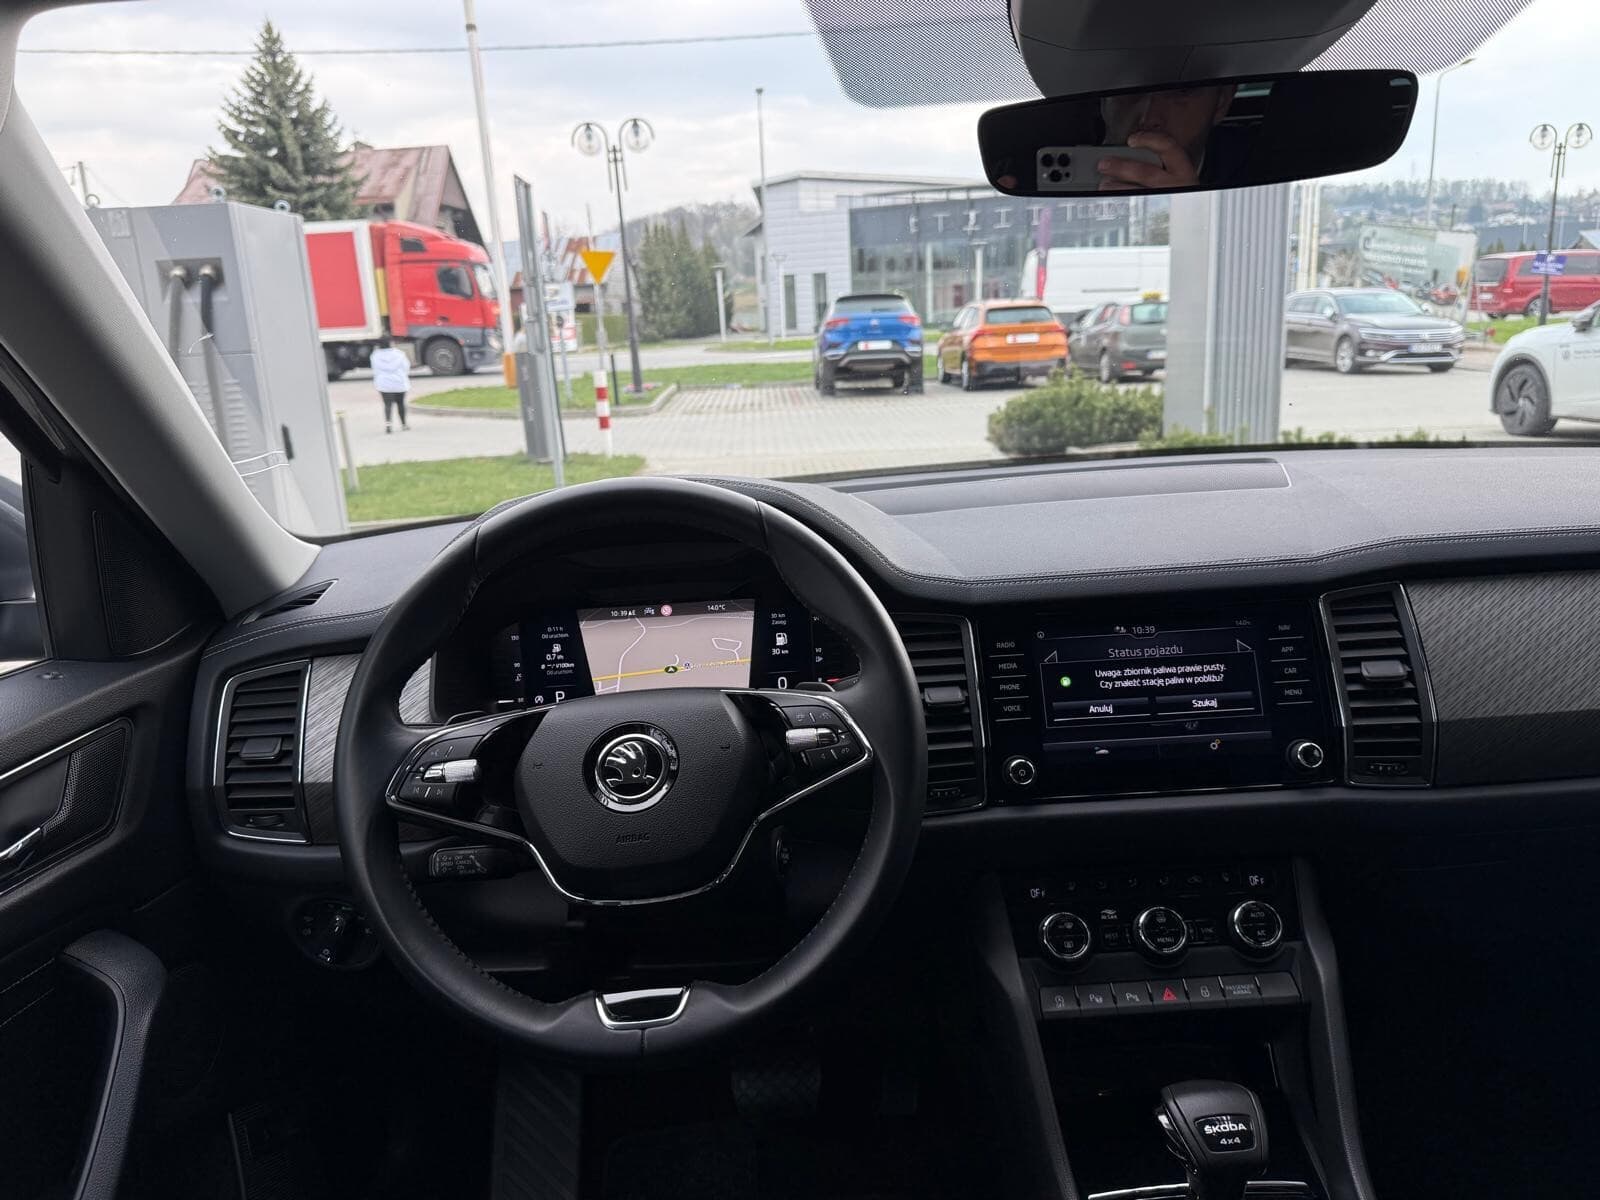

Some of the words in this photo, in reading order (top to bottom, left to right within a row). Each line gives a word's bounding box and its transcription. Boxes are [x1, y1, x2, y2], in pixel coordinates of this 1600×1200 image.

[1132, 626, 1156, 634] 10:39
[1108, 648, 1142, 658] Status
[1144, 645, 1183, 658] pojazdu
[1094, 669, 1122, 678] Uwaga:
[1124, 666, 1152, 676] zbiornik
[1153, 666, 1176, 675] paliwa
[1178, 664, 1202, 674] prawie
[1204, 663, 1226, 672] pusty.
[1100, 680, 1112, 689] Czy
[1142, 677, 1164, 688] stację
[1165, 676, 1184, 686] paliw
[1194, 674, 1224, 684] pobliżu?
[555, 690, 565, 703] P
[1192, 698, 1218, 708] Szukaj
[1089, 704, 1113, 714] Anuluj
[616, 832, 650, 843] AIRBAG
[1204, 1122, 1247, 1134] ŠKODA
[1220, 1136, 1241, 1145] 4x4
